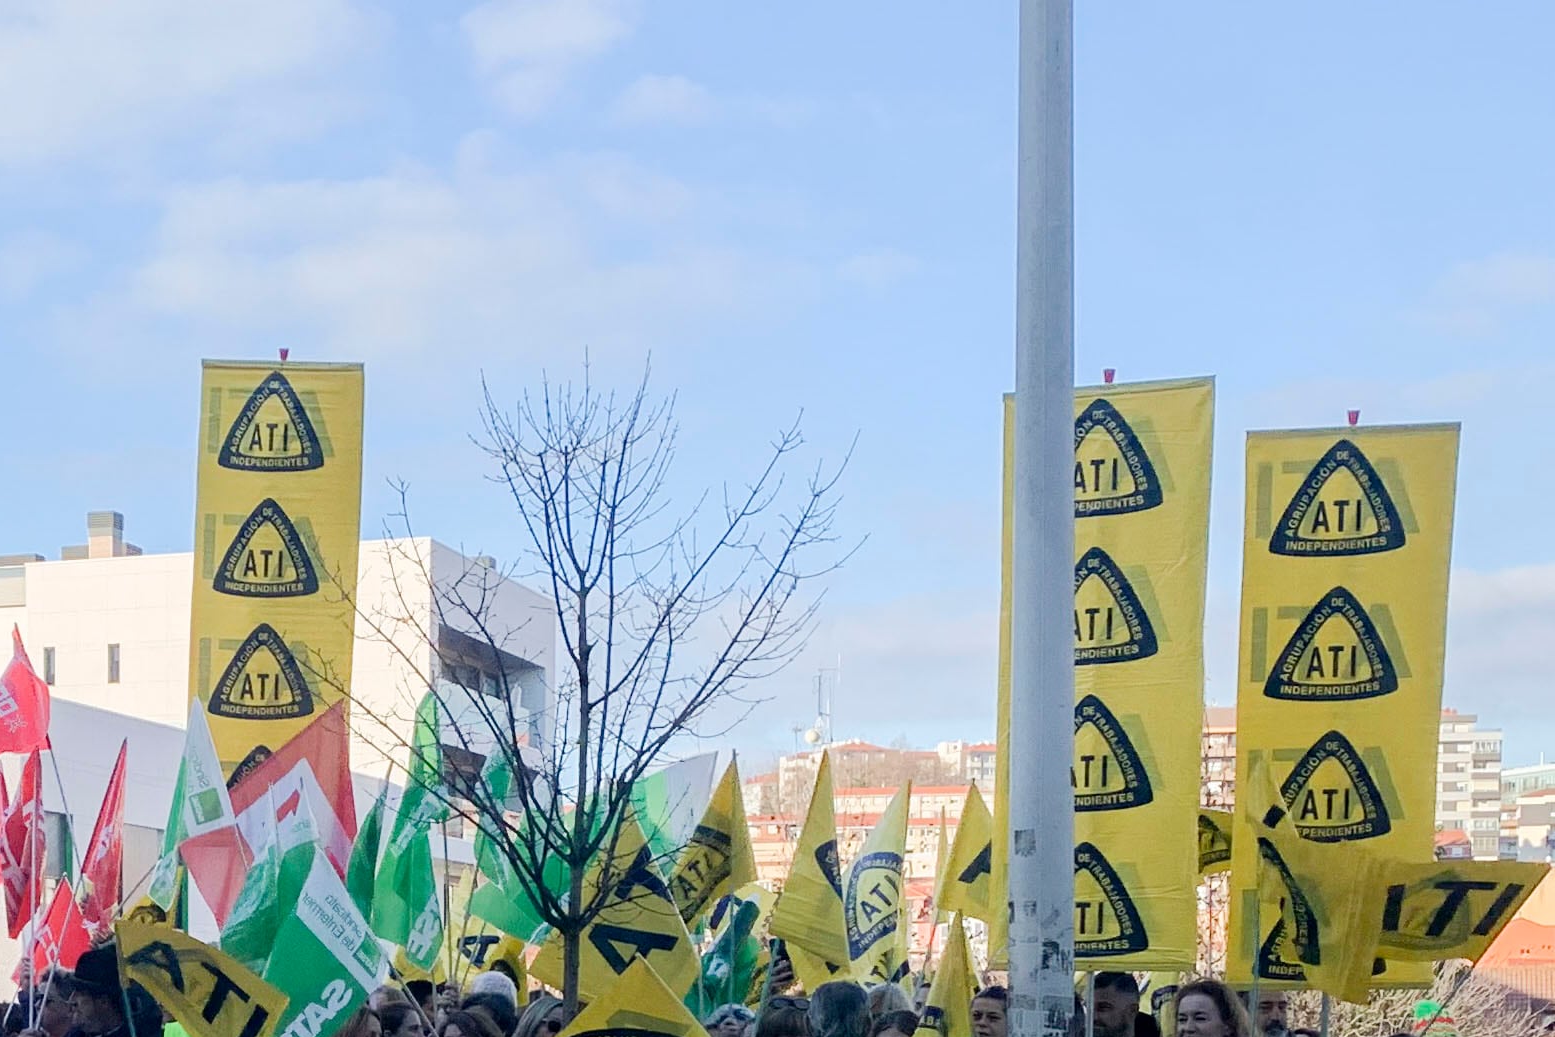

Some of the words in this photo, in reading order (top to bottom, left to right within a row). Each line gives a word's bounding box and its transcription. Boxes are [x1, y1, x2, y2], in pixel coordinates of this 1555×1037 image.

[248, 423, 289, 452] ATI
[1101, 415, 1149, 491] TRABAJADORES
[230, 456, 309, 467] INDEPENDIENTES
[1336, 450, 1350, 461] DE
[1347, 457, 1391, 533] TRABAJADORES
[1312, 499, 1362, 533] ATI
[262, 507, 274, 517] DE
[270, 512, 308, 580] TRABAJADORES
[1285, 536, 1388, 551] INDEPENDIENTES
[243, 549, 284, 578] ATI
[224, 582, 305, 594] INDEPENDIENTES
[1087, 558, 1101, 569] DE
[1097, 564, 1144, 641] TRABAJADORES
[1331, 597, 1345, 607] DE
[1342, 604, 1385, 678] TRABAJADORES
[1306, 645, 1357, 679] ATI
[240, 673, 280, 701] ATI
[1280, 681, 1381, 696] INDEPENDIENTES
[220, 704, 300, 715] INDEPENDIENTES
[1082, 705, 1095, 716] DE
[1092, 711, 1139, 789] TRABAJADORES
[1325, 741, 1340, 751] DE
[1335, 747, 1377, 820] TRABAJADORES
[1299, 788, 1350, 820] ATI
[860, 874, 900, 923] ATI
[1077, 853, 1091, 864] DE
[1087, 858, 1134, 937] TRABAJADORES
[1075, 902, 1104, 935] TI
